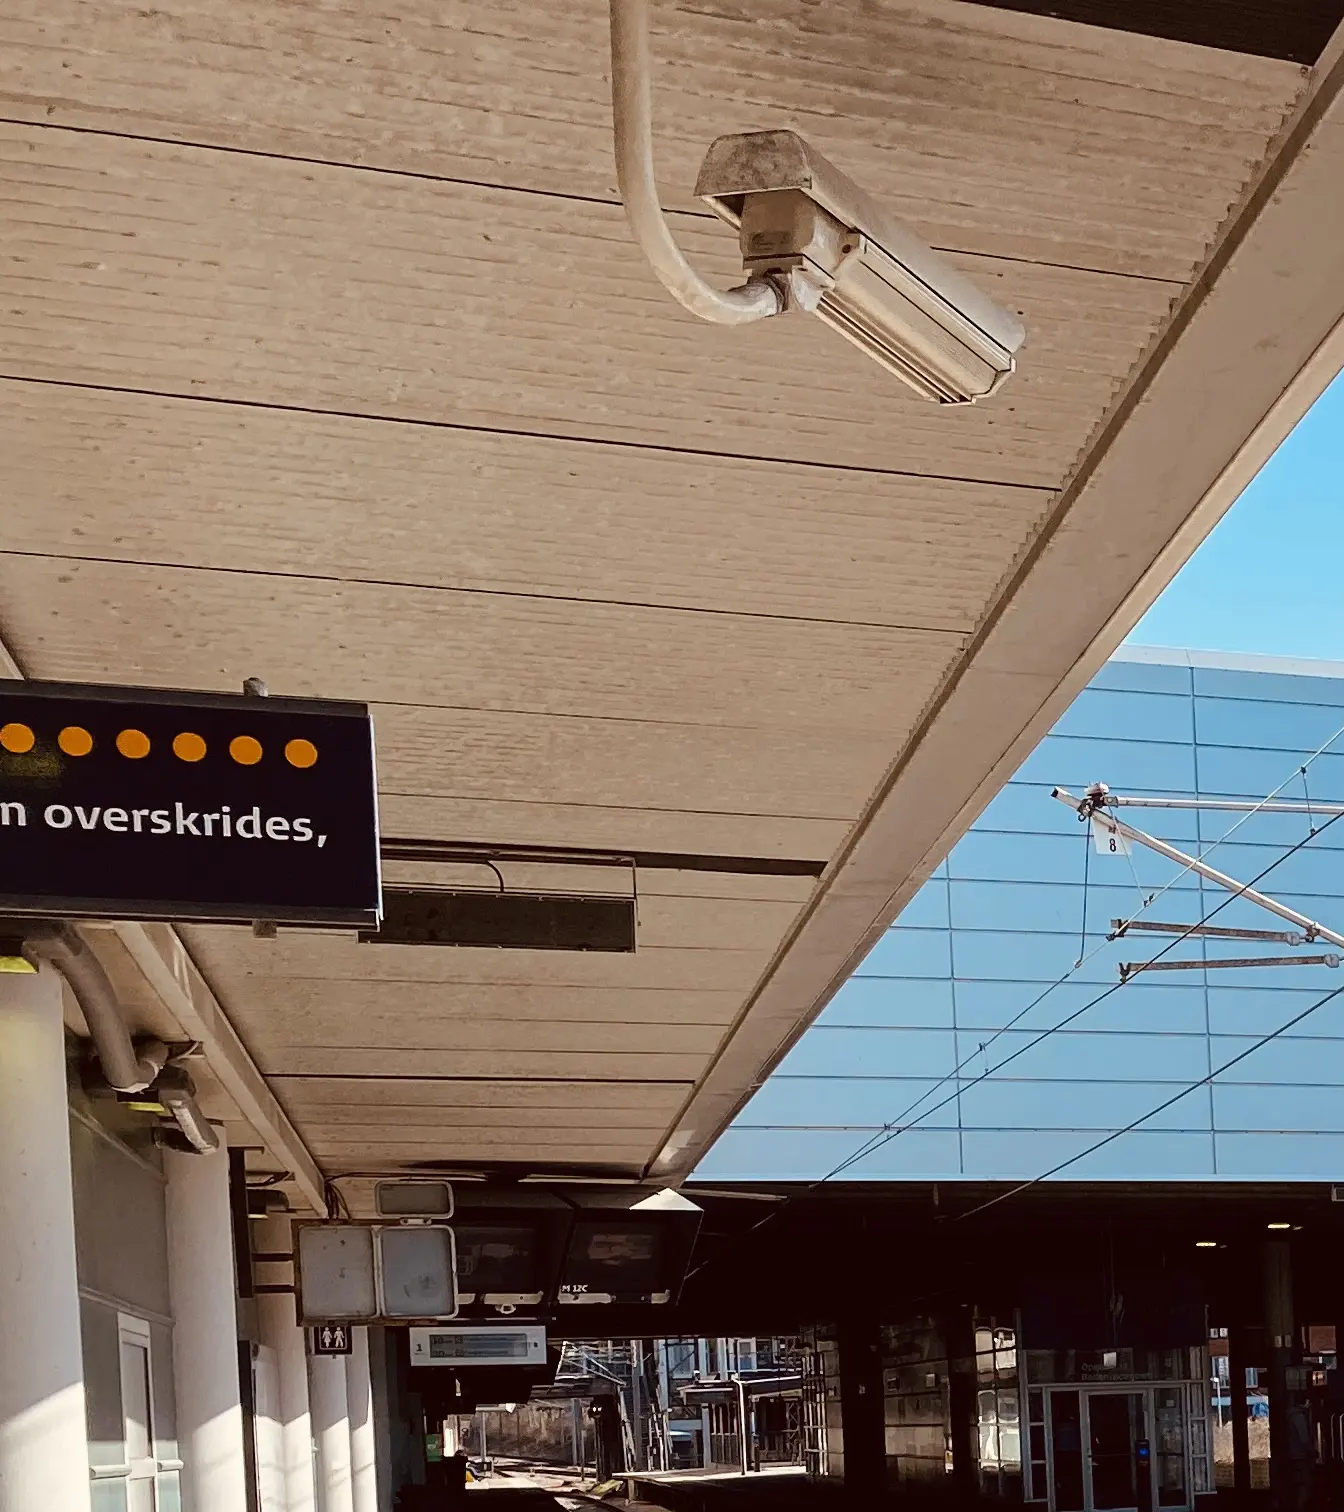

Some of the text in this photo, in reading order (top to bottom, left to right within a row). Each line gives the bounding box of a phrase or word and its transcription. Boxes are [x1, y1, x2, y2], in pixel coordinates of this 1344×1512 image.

[44, 802, 328, 848] overskrides,
[1109, 838, 1117, 852] 8
[416, 1343, 423, 1352] 1
